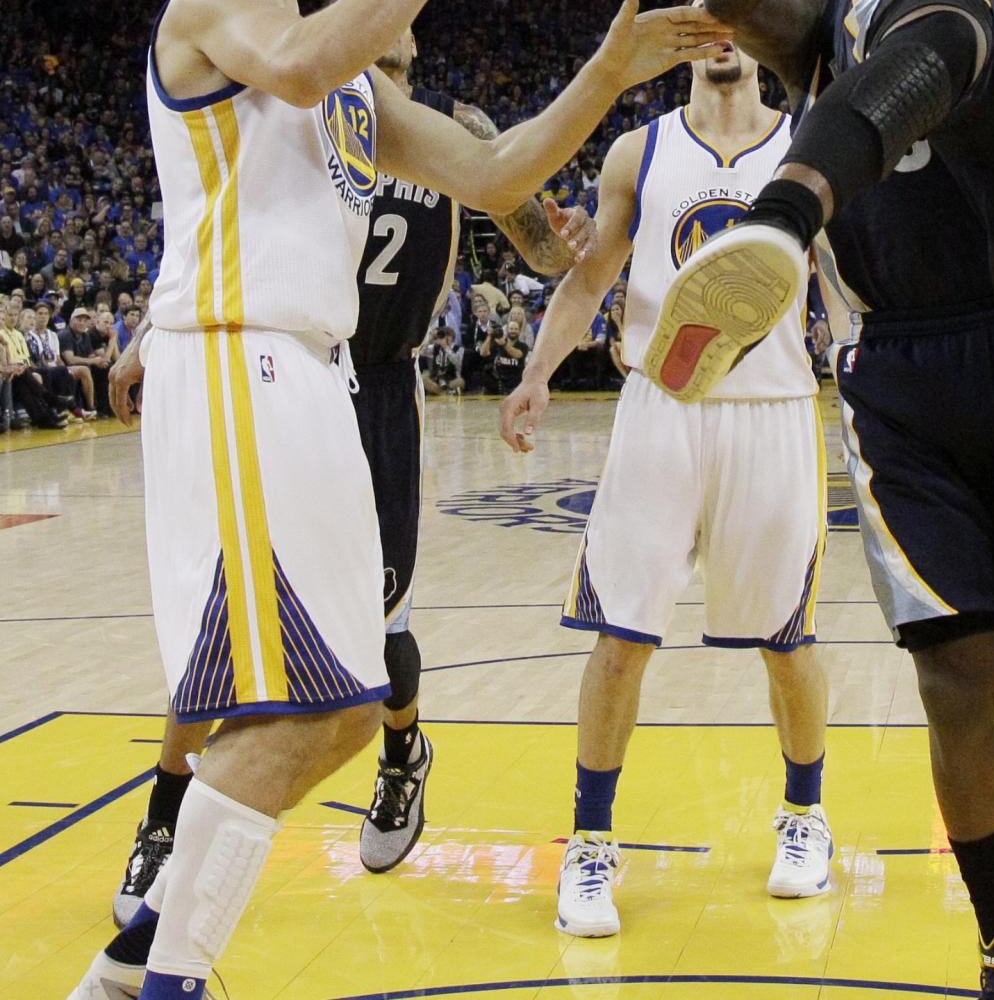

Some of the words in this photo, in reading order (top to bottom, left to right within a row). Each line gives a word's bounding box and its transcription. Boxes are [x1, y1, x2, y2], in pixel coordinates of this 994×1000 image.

[348, 105, 369, 139] 12
[376, 171, 440, 209] PHIS
[672, 188, 729, 218] GOLDEN
